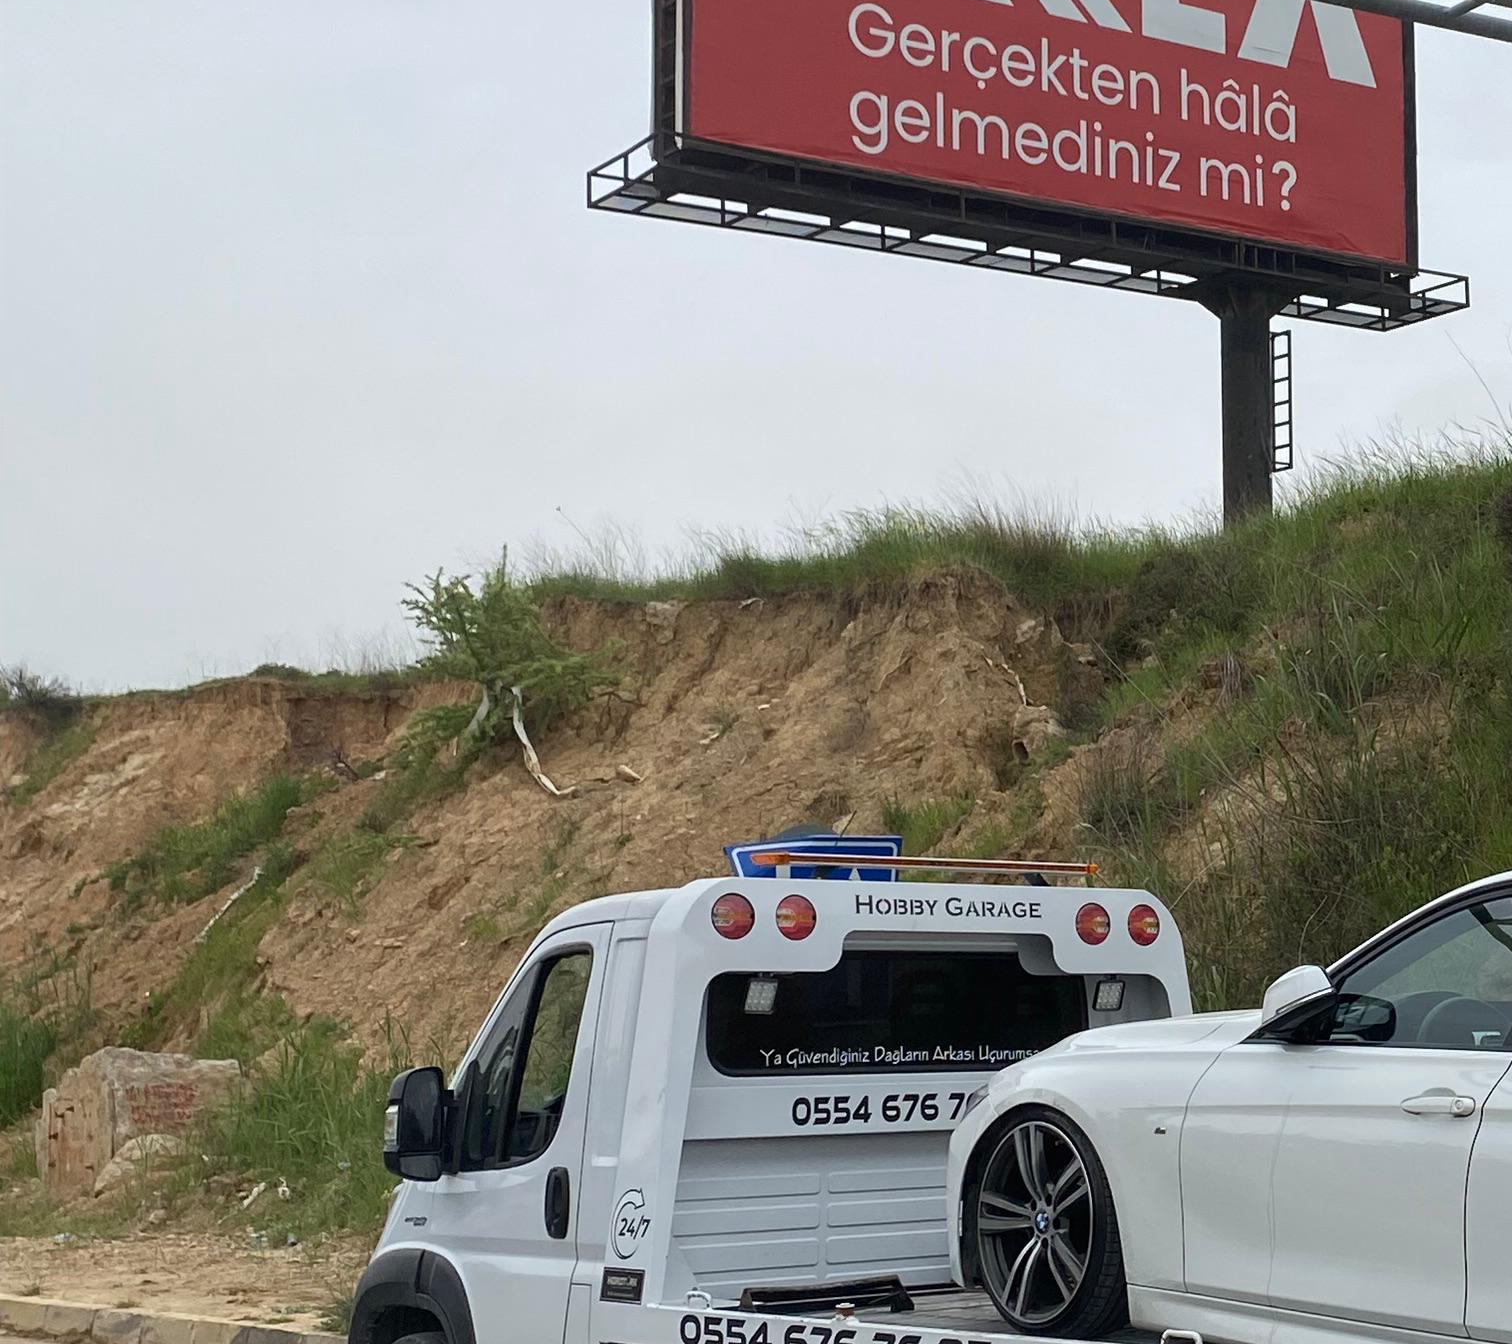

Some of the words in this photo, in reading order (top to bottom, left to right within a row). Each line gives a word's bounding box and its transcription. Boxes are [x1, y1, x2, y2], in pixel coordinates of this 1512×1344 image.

[848, 2, 1161, 115] Gerçekten
[1180, 67, 1297, 143] hâlâ
[849, 89, 1181, 192] gelmediniz
[1199, 154, 1298, 211] mi?
[855, 894, 938, 916] HOBBY
[945, 897, 1042, 919] GARAGE
[760, 1048, 782, 1067] Ya
[791, 1095, 873, 1126] 0554
[881, 1092, 939, 1122] 676
[948, 1092, 971, 1121] 7
[618, 1215, 651, 1240] 24/7
